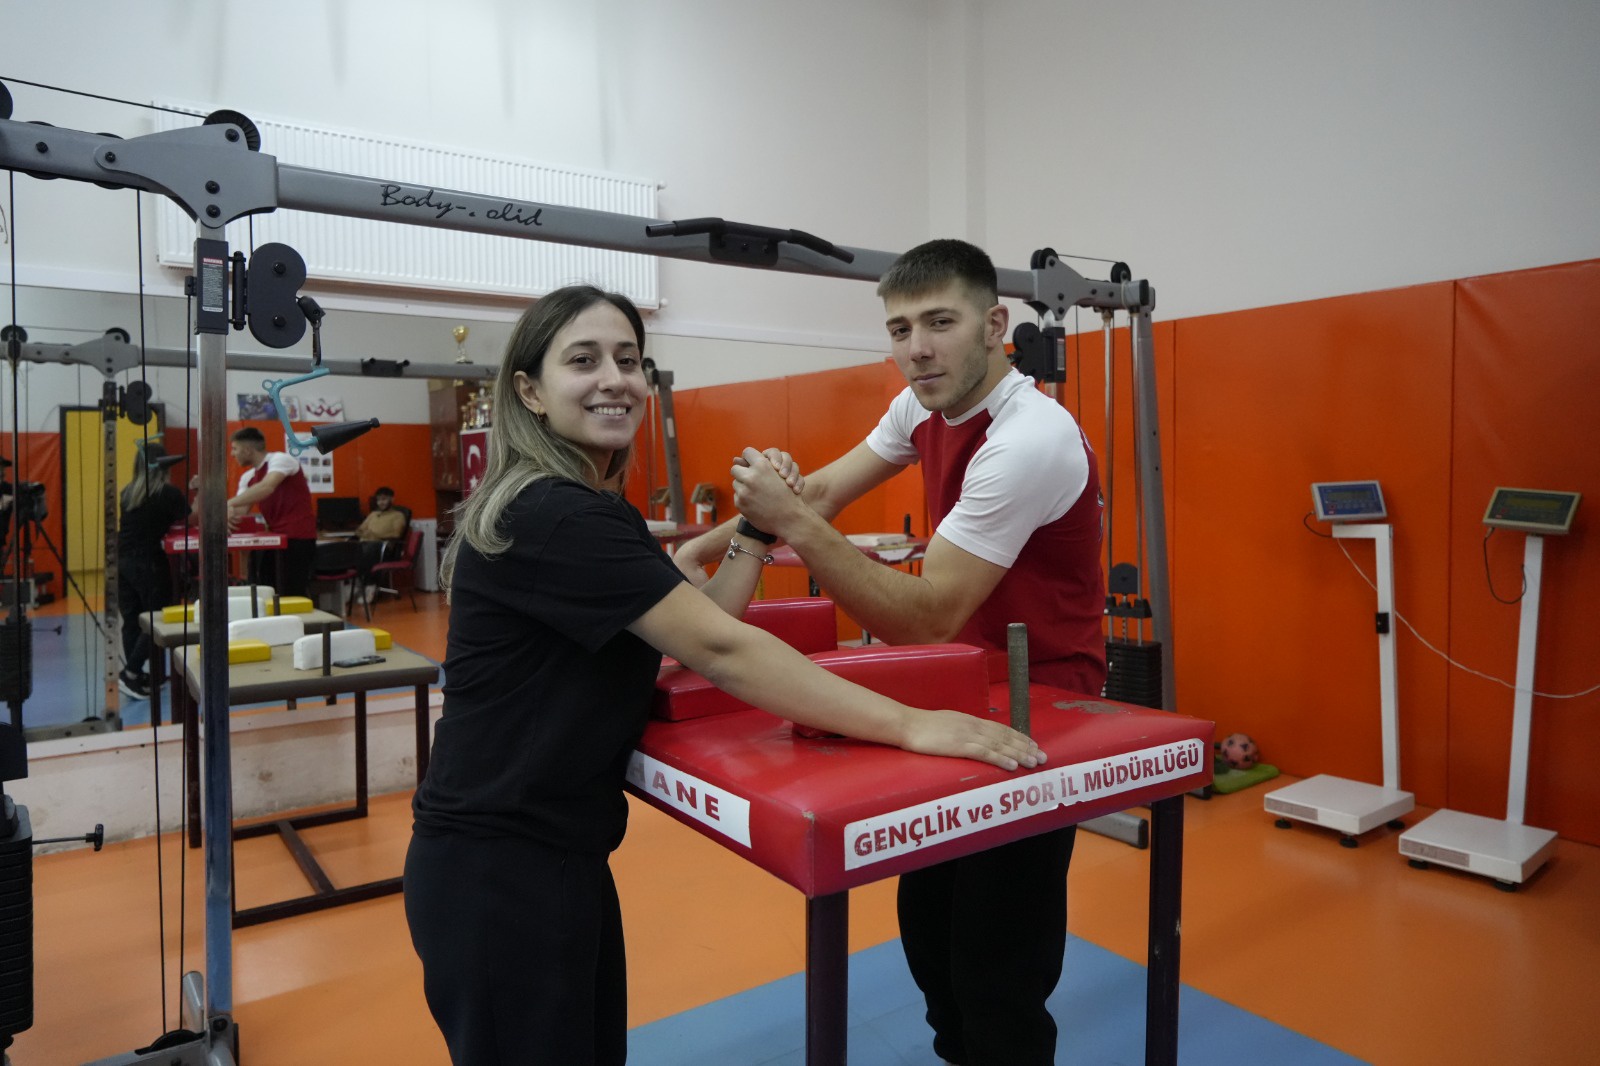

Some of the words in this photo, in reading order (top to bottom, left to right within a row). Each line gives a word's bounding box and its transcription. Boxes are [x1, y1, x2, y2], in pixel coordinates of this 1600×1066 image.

[380, 184, 543, 227] Body-olid
[854, 805, 962, 857] GENÇLİK
[967, 803, 993, 824] ve
[999, 781, 1055, 815] SPOR
[1060, 772, 1079, 798] İL
[1084, 743, 1199, 793] MÜDÜRLÜĞÜ
